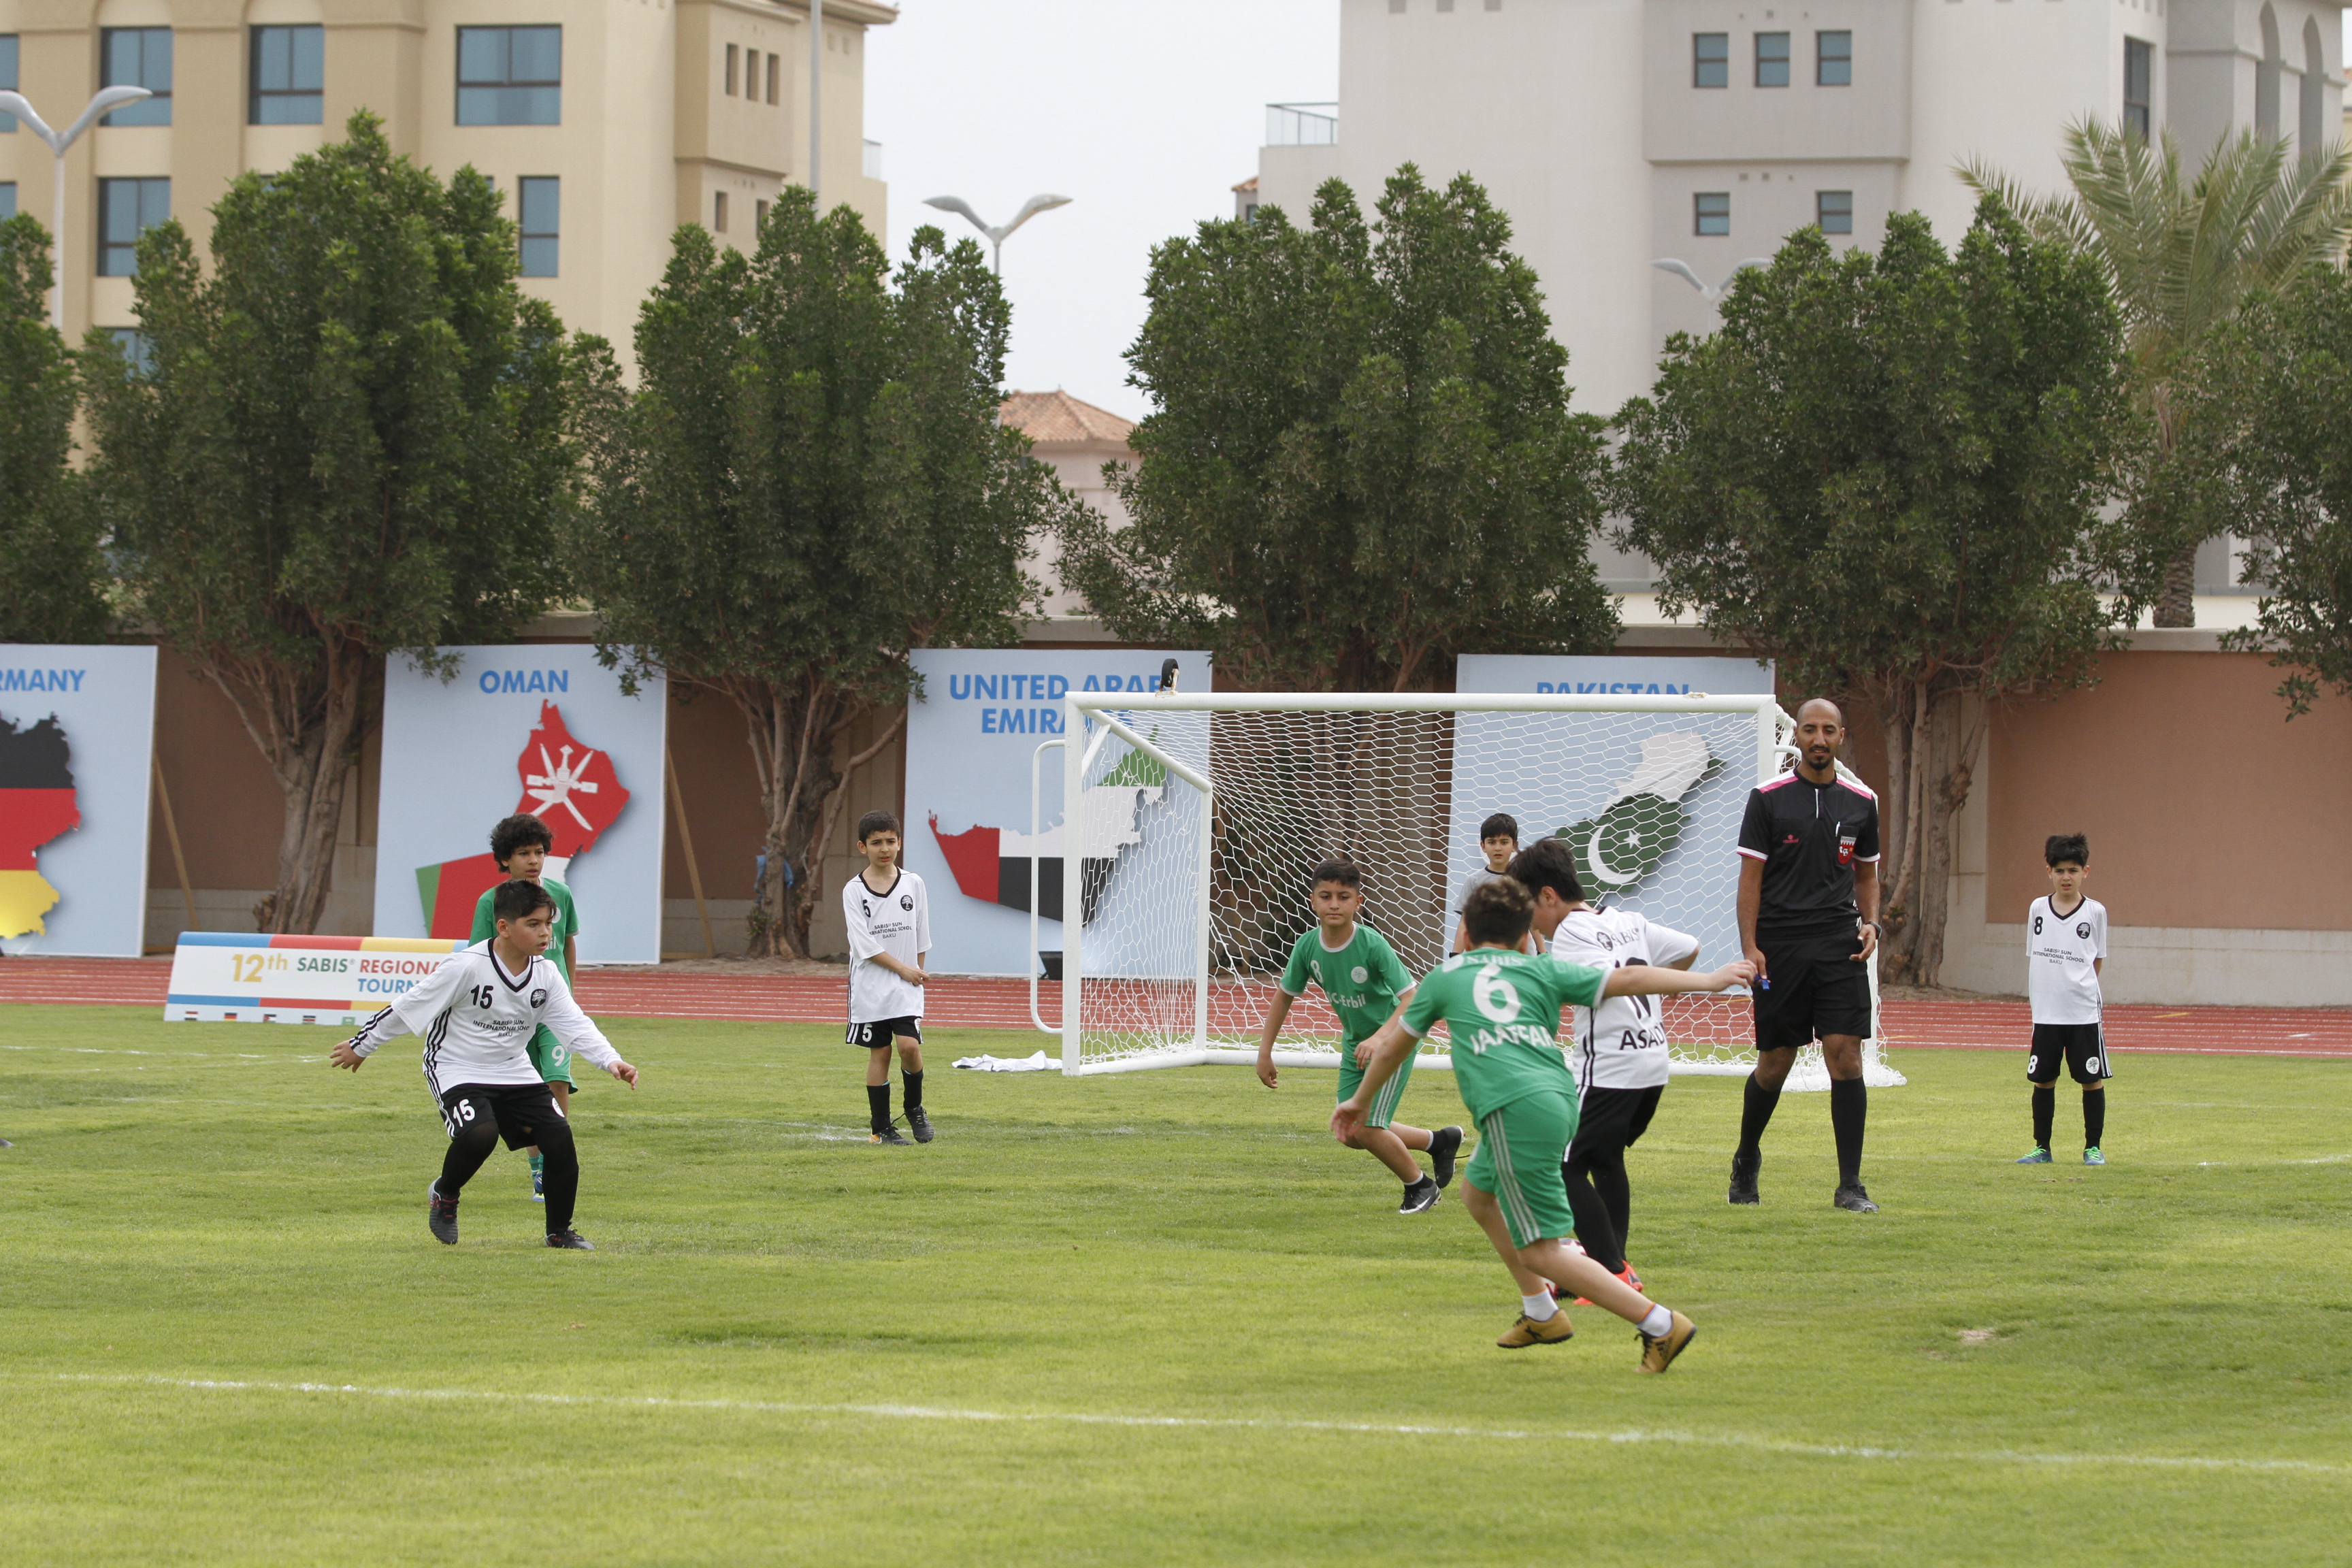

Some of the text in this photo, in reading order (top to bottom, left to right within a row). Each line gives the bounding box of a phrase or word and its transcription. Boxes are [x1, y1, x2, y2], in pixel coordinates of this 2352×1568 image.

[0, 669, 86, 691] MANY
[480, 670, 568, 693] OMAN
[949, 674, 1069, 700] UNITED
[862, 899, 871, 918] 5
[2034, 916, 2043, 936] 8
[231, 953, 289, 982] 12th
[1310, 960, 1324, 984] 8
[470, 984, 494, 1009] 15
[1473, 962, 1522, 1024] 6
[862, 1023, 872, 1043] 5
[551, 1045, 566, 1067] 9
[2027, 1055, 2038, 1074] 8
[453, 1098, 476, 1128] 15
